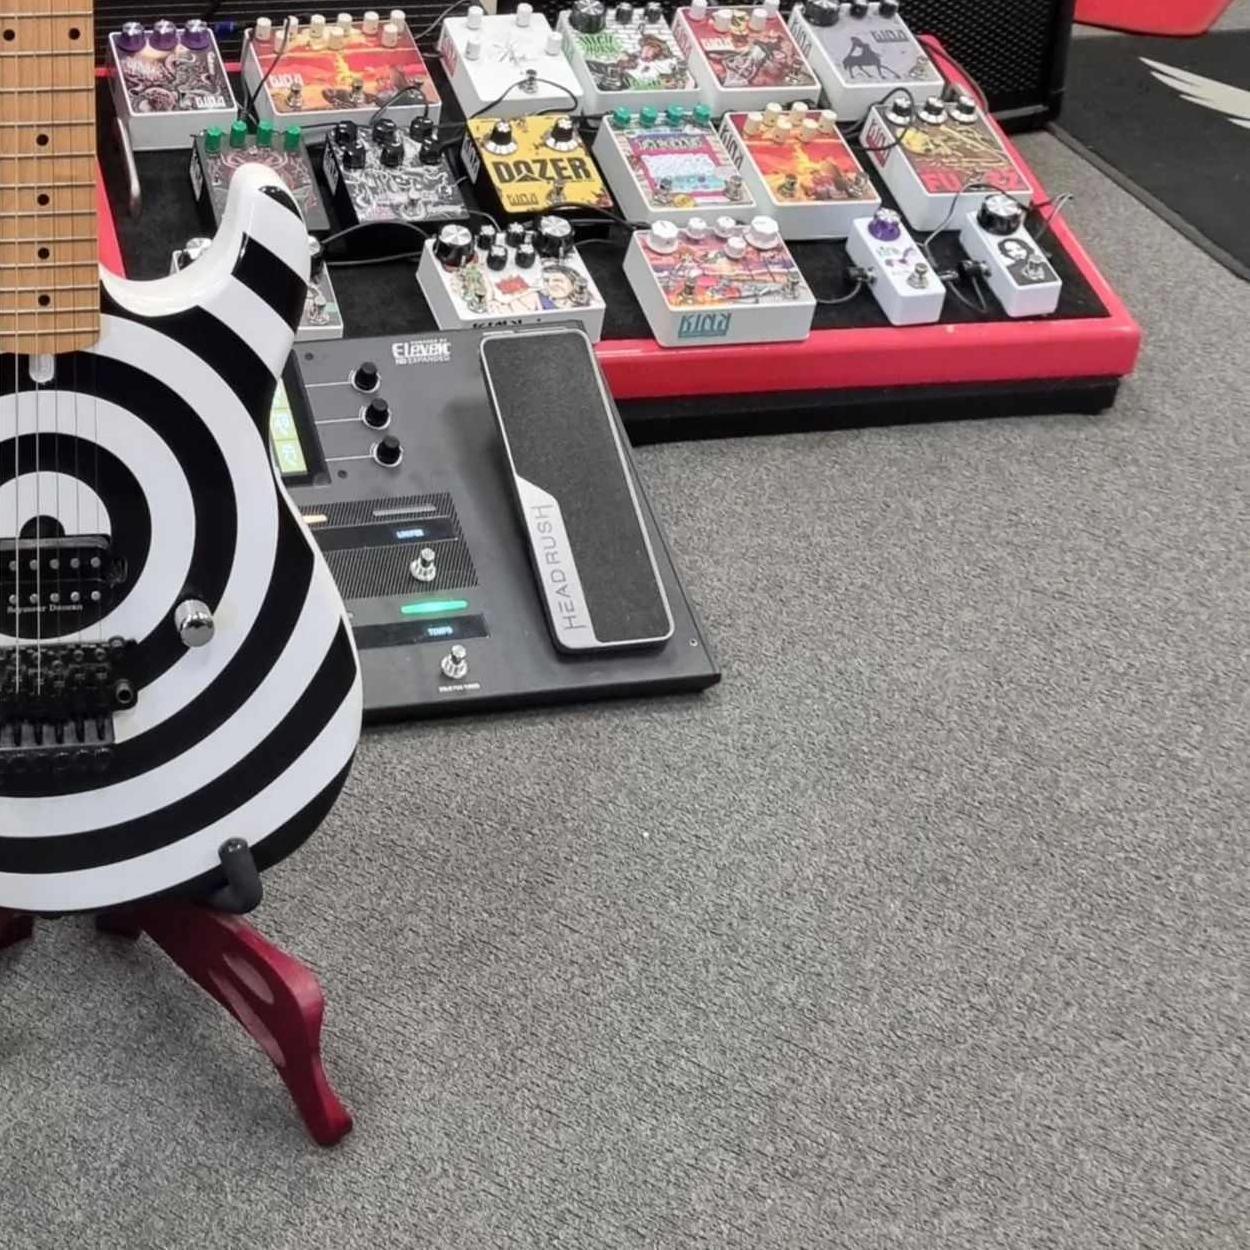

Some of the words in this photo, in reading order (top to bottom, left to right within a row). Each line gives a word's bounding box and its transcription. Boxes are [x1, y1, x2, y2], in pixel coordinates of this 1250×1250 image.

[491, 156, 592, 183] DOZER
[396, 528, 424, 539] LOOPER
[531, 502, 587, 631] HEADRUSH
[7, 605, 47, 614] Seymour
[50, 603, 83, 613] Duncan
[427, 626, 454, 636] TEMPO
